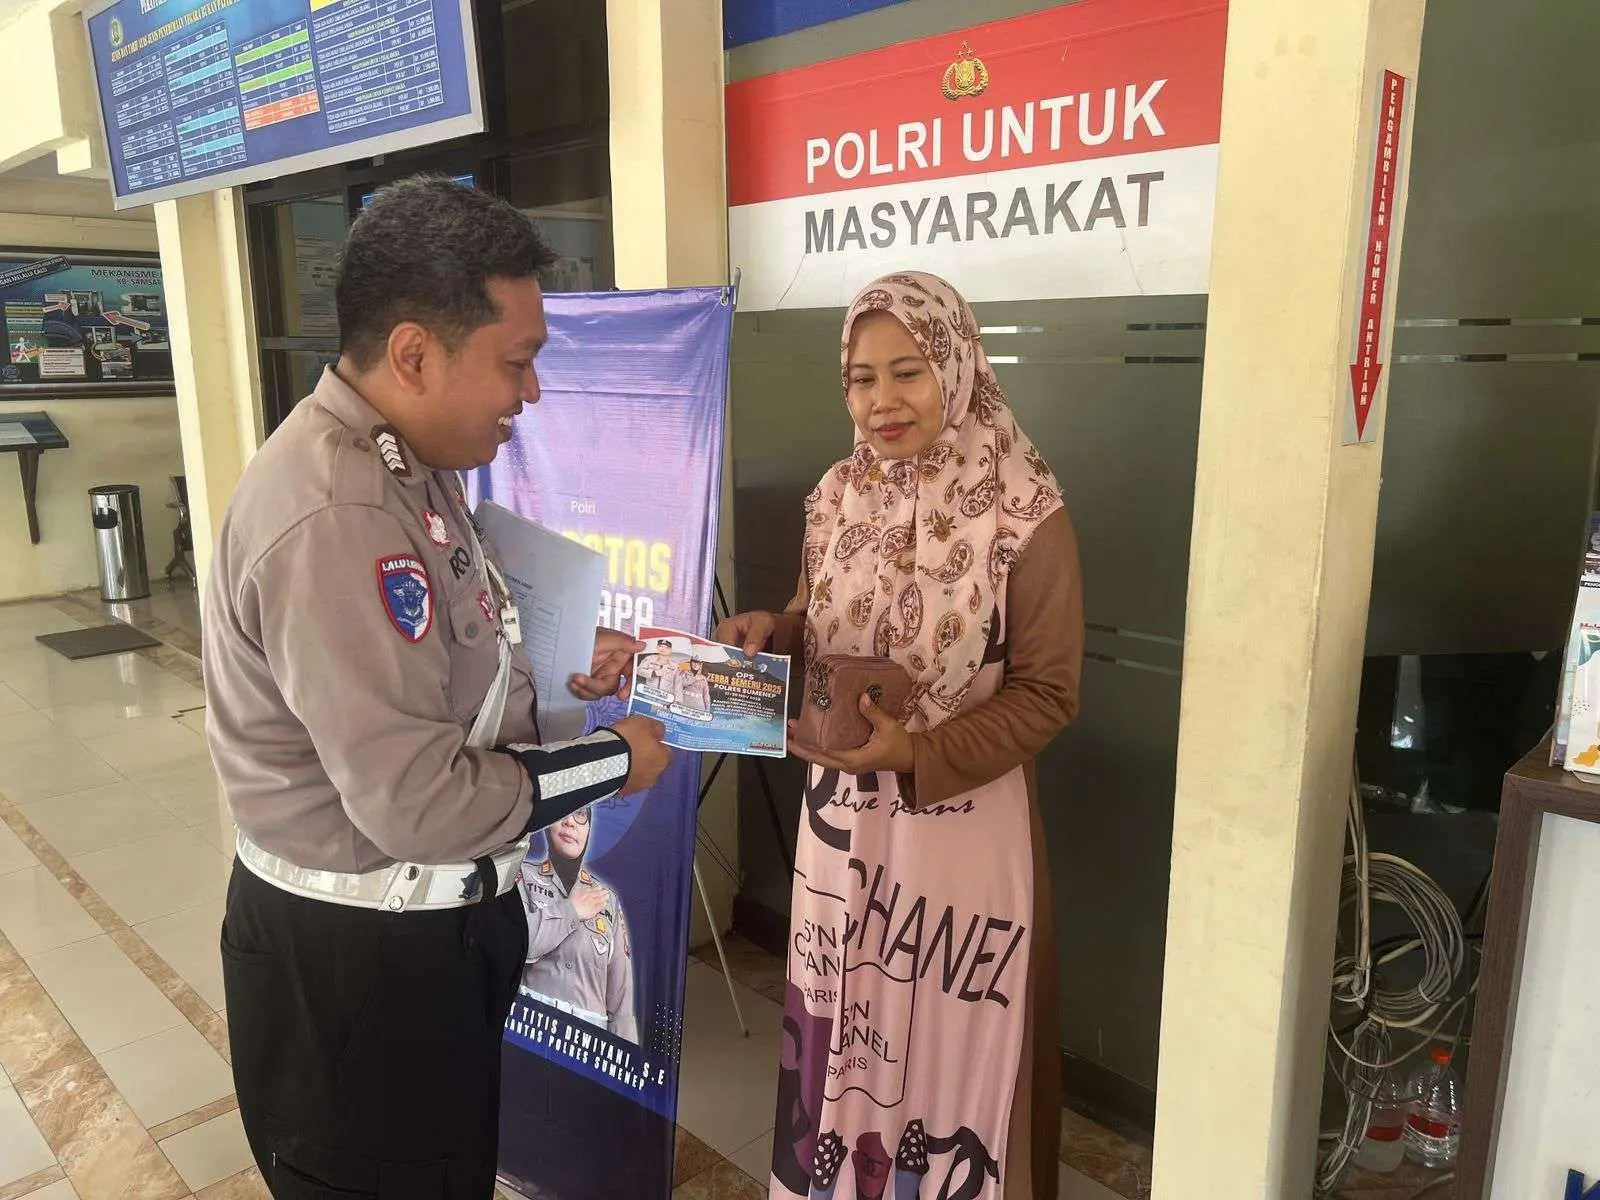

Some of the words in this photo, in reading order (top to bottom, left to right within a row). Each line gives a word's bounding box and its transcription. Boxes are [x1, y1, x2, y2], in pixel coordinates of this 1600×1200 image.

[805, 116, 943, 184] POLRI
[962, 78, 1168, 163] UNTUK
[1378, 78, 1398, 226] PENGAMBILAN
[804, 171, 1165, 255] MASYARAKAT
[1359, 318, 1376, 406] ANTRIAN
[571, 500, 596, 515] Polri
[381, 558, 406, 571] LALU
[561, 530, 671, 593] TAS
[707, 672, 730, 685] ZEBRA
[730, 677, 762, 691] SEMERU
[762, 682, 783, 694] 2025
[713, 683, 741, 694] POLRES
[742, 688, 777, 698] SUMENEP
[735, 671, 755, 680] OPS
[523, 1006, 558, 1035] TITIS
[564, 1024, 635, 1072] DEWIYANI,
[642, 1061, 665, 1085] S.E
[548, 1035, 589, 1064] POLRES
[594, 1056, 645, 1091] SUMENEP
[827, 1056, 868, 1081] PARIS
